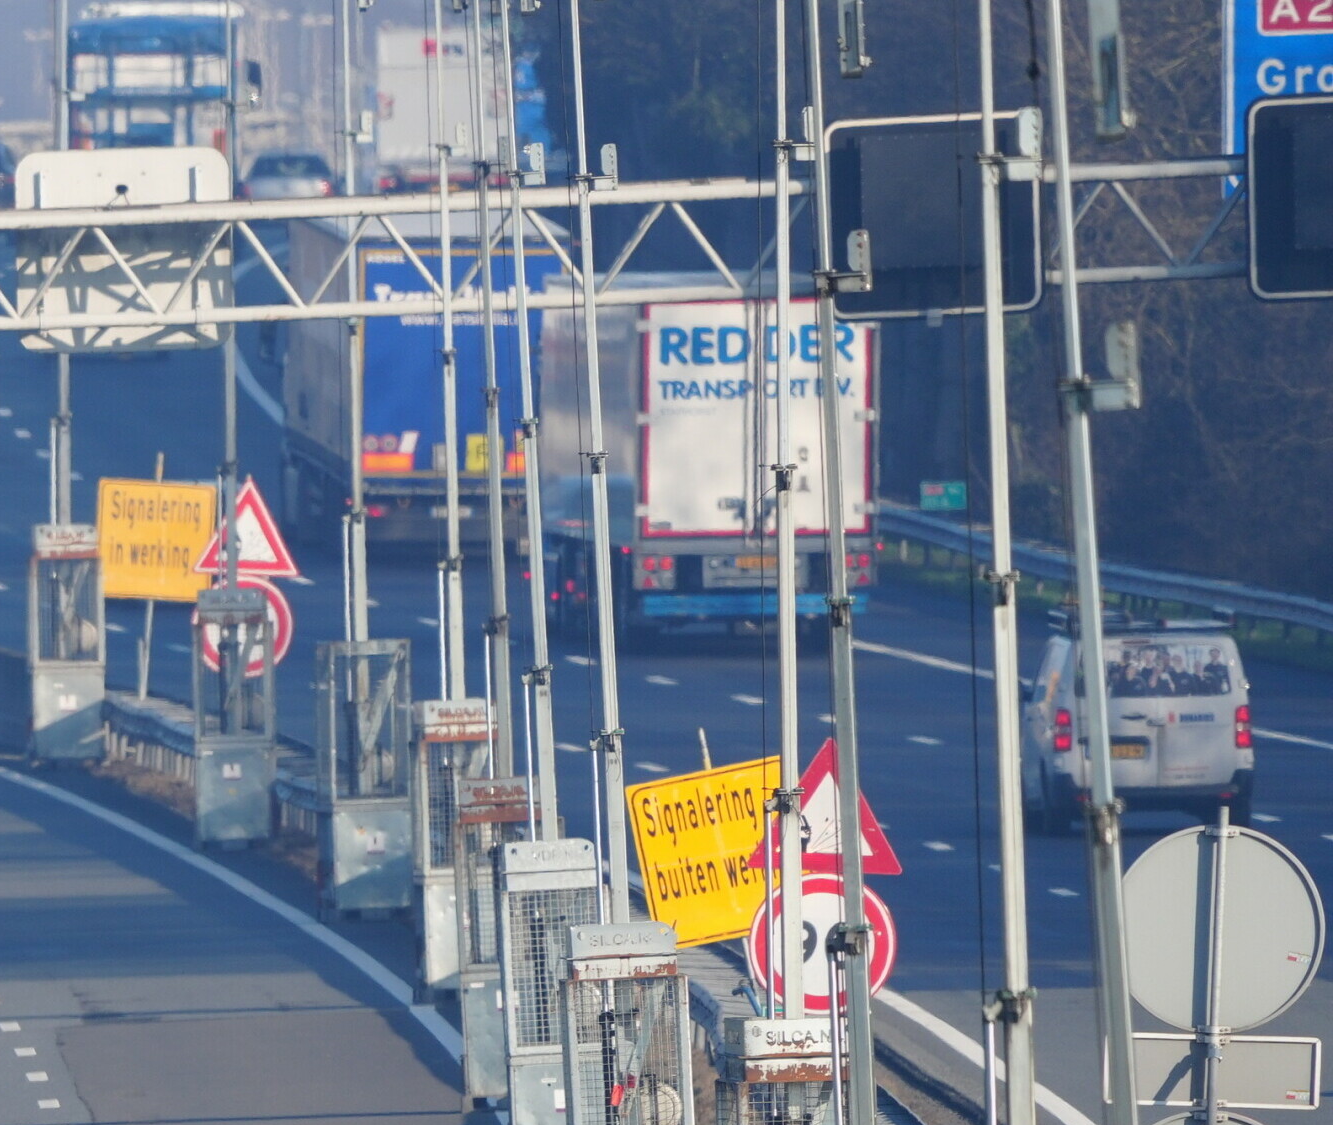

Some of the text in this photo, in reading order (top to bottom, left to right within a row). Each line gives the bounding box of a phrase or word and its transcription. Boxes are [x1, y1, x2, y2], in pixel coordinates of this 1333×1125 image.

[111, 490, 201, 532] Signalering
[109, 537, 190, 578] in werking
[642, 784, 757, 847] Signalering
[654, 859, 720, 902] buiten
